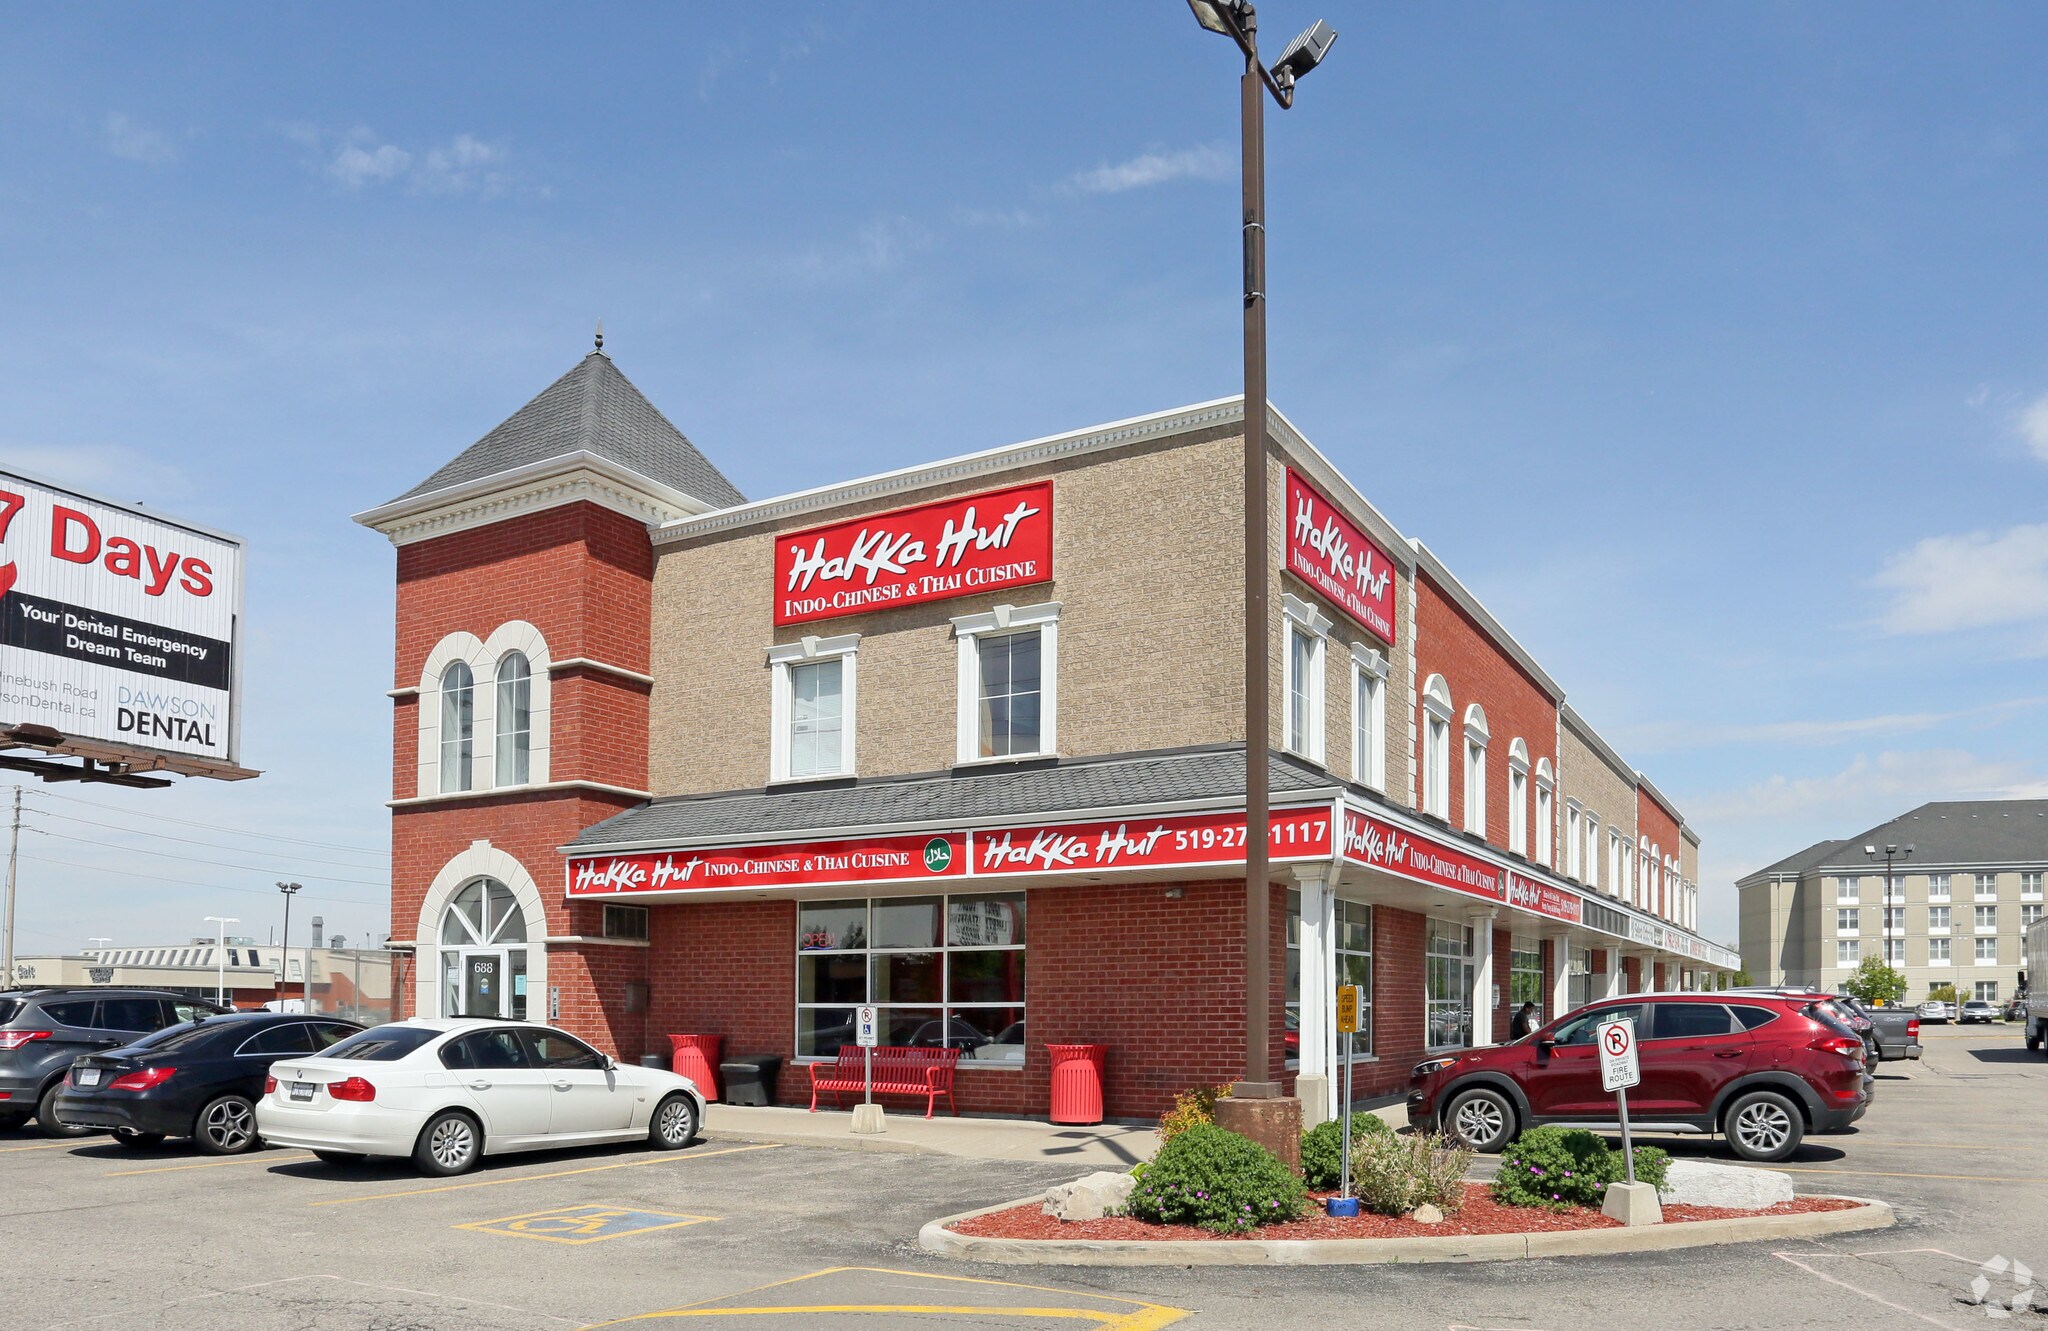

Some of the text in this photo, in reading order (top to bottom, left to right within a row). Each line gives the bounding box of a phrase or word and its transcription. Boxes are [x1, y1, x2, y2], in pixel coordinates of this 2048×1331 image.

[51, 504, 213, 597] Days
[935, 501, 1040, 569] Hut
[784, 560, 1037, 617] INDO-CHINESE & THAI CUISINE
[1293, 546, 1391, 638] INDO-CHINESE & THAI CUISINE
[1356, 550, 1391, 603] Hut
[19, 602, 208, 661] Your Dental Emergency
[66, 634, 167, 669] Dream Team
[0, 692, 96, 718] sonDental.ca
[62, 682, 97, 700] Road
[118, 686, 216, 721] DAWSON
[117, 707, 216, 747] DENTAL
[1095, 823, 1172, 864] Hut
[1385, 830, 1409, 866] Hut
[1410, 847, 1457, 880] INDO-CHINESE
[1461, 864, 1476, 885] THAI
[1475, 870, 1496, 891] CUISINE
[651, 854, 703, 890] Hut
[704, 858, 800, 877] INDO-CHINESE
[803, 858, 813, 871] &
[814, 854, 849, 870] THAI
[851, 851, 910, 868] CUISINE
[803, 933, 834, 946] OPEN
[474, 962, 493, 974] 688
[1341, 994, 1354, 1003] SPEED
[1341, 1004, 1353, 1014] BUMP
[1340, 1015, 1354, 1024] AHEAD
[1609, 1072, 1633, 1084] ROUTE
[1612, 1065, 1628, 1076] FIRE
